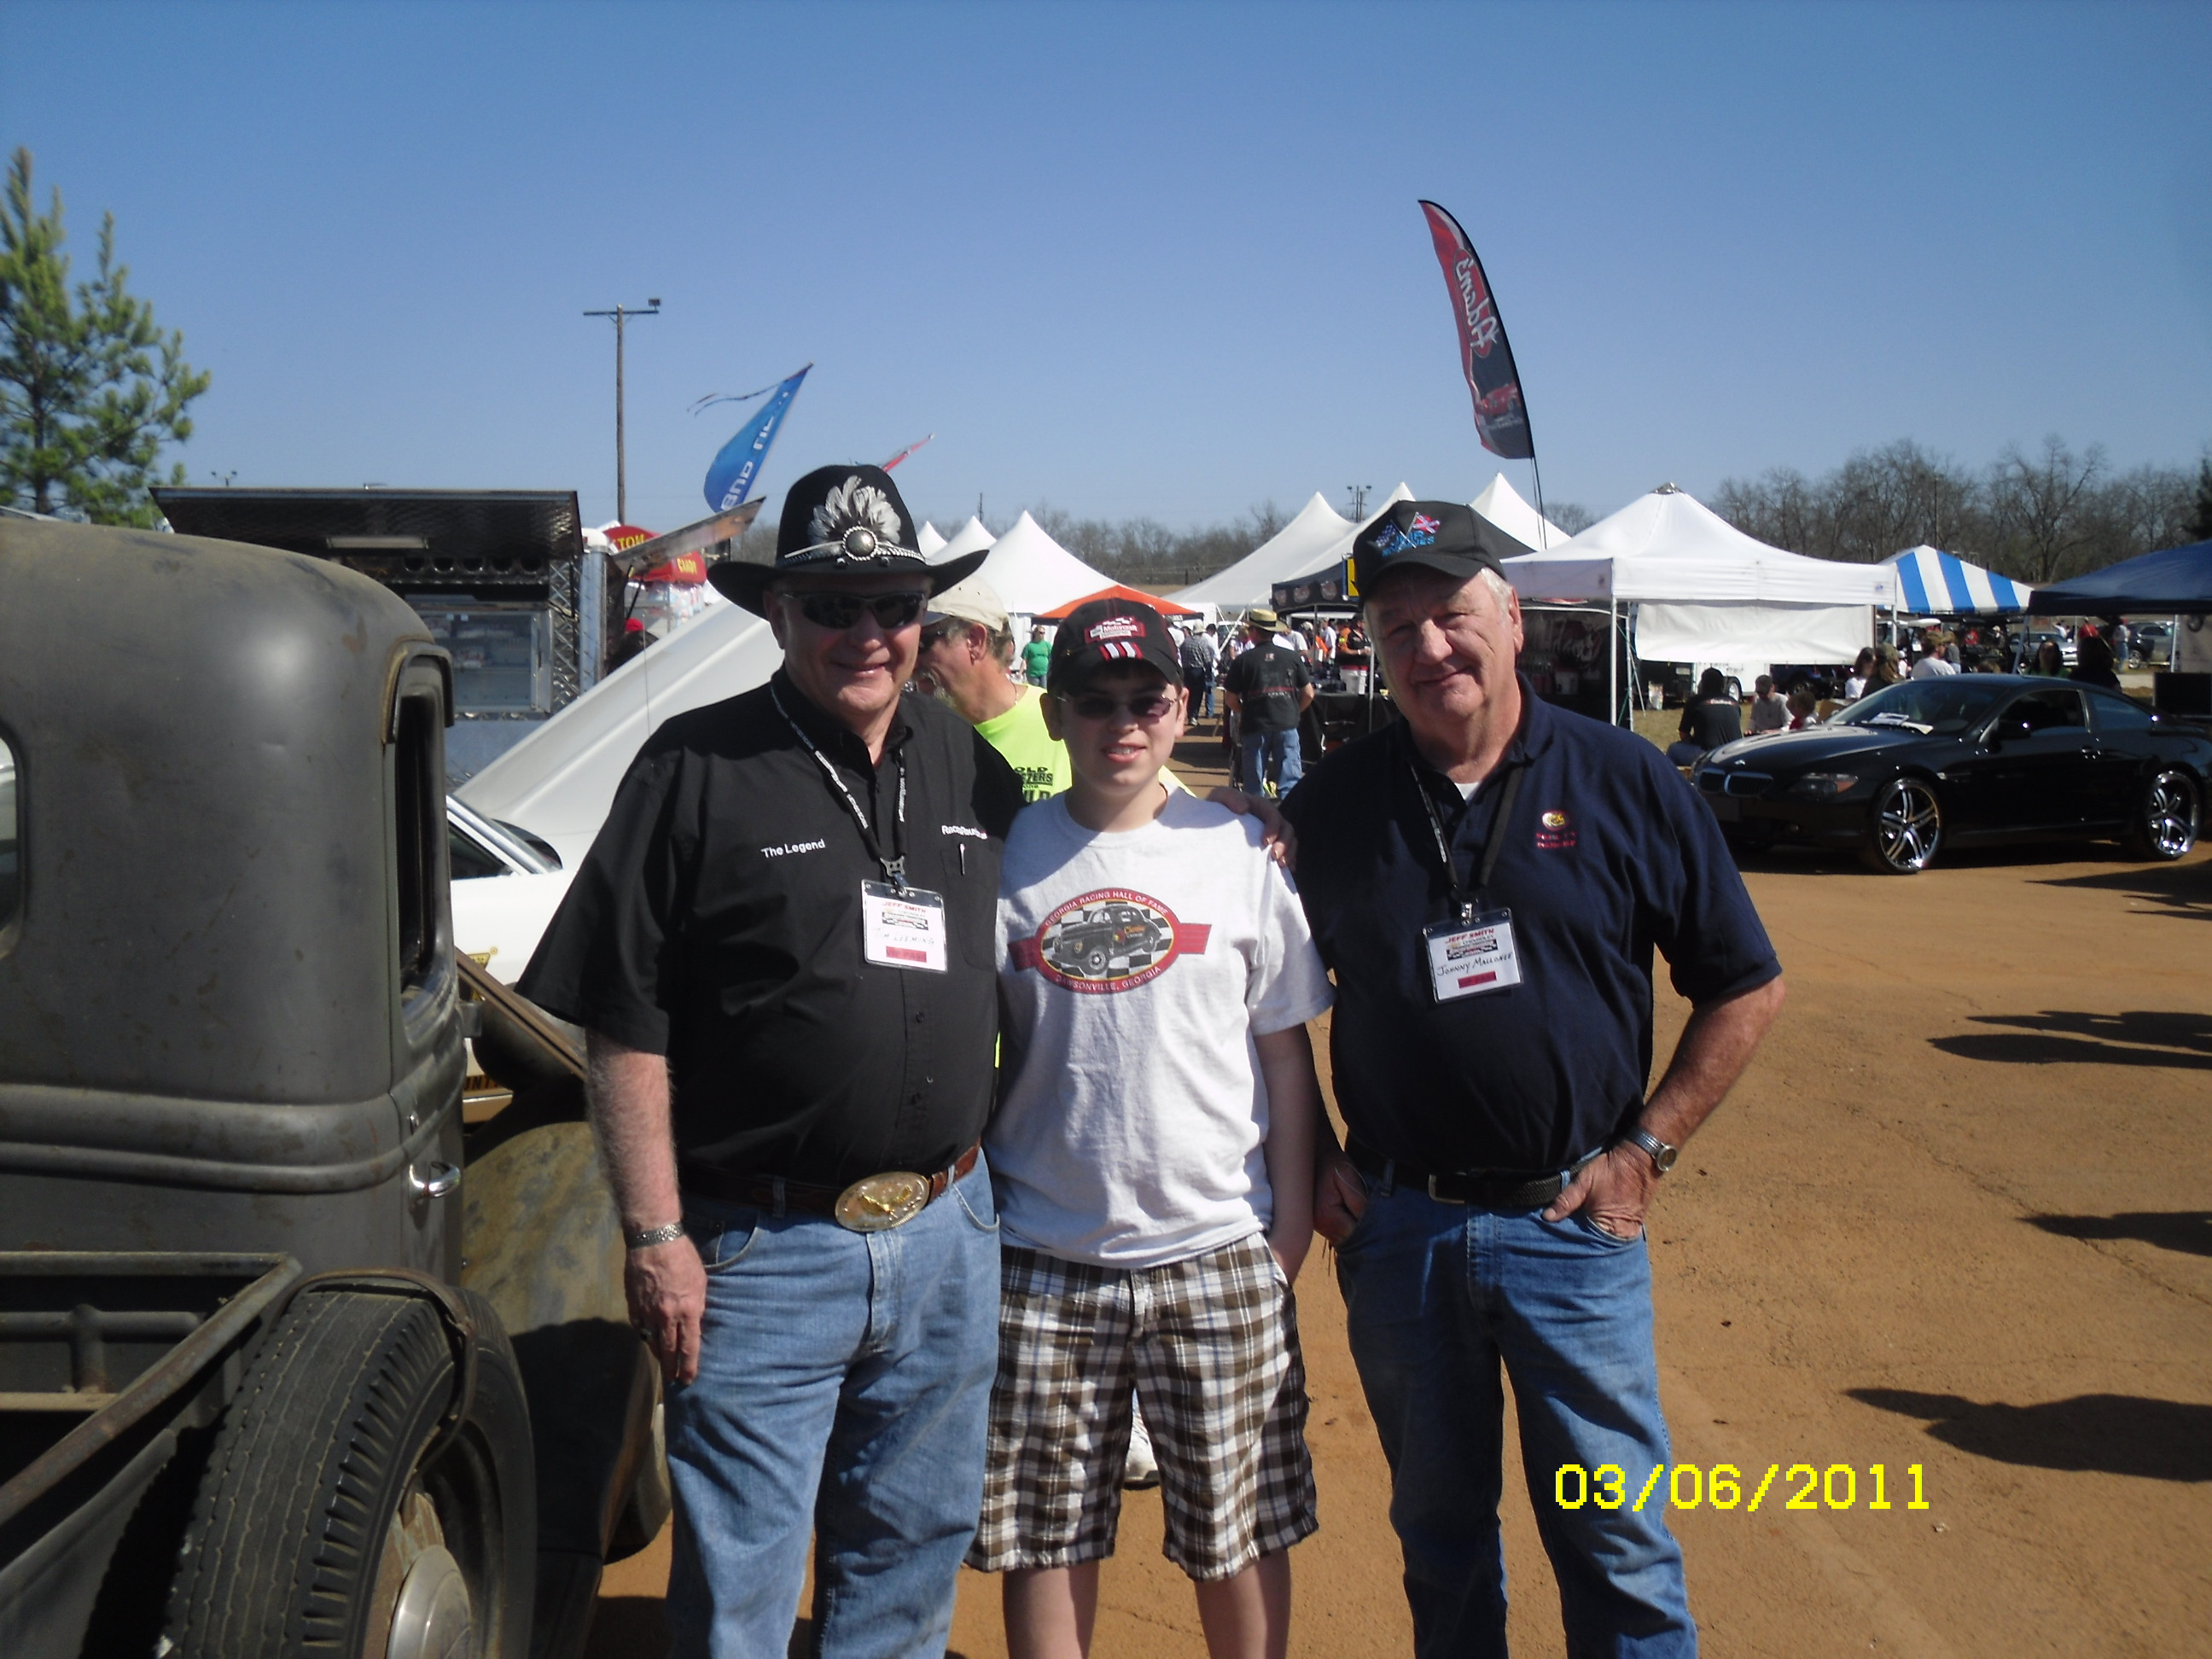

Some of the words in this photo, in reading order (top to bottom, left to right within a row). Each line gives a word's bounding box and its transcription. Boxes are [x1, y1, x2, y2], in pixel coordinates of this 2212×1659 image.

[760, 847, 783, 859] The
[783, 838, 826, 853] Legend
[905, 905, 926, 913] SMITH
[1045, 903, 1078, 926] GEORGIA
[1079, 891, 1110, 905] RACING
[1112, 890, 1132, 900] HALL
[1135, 894, 1147, 904] OF
[1148, 899, 1168, 916] FAME
[1445, 934, 1468, 944] JEFF
[1470, 928, 1494, 938] SMITH
[1121, 966, 1161, 989] GEORGIA
